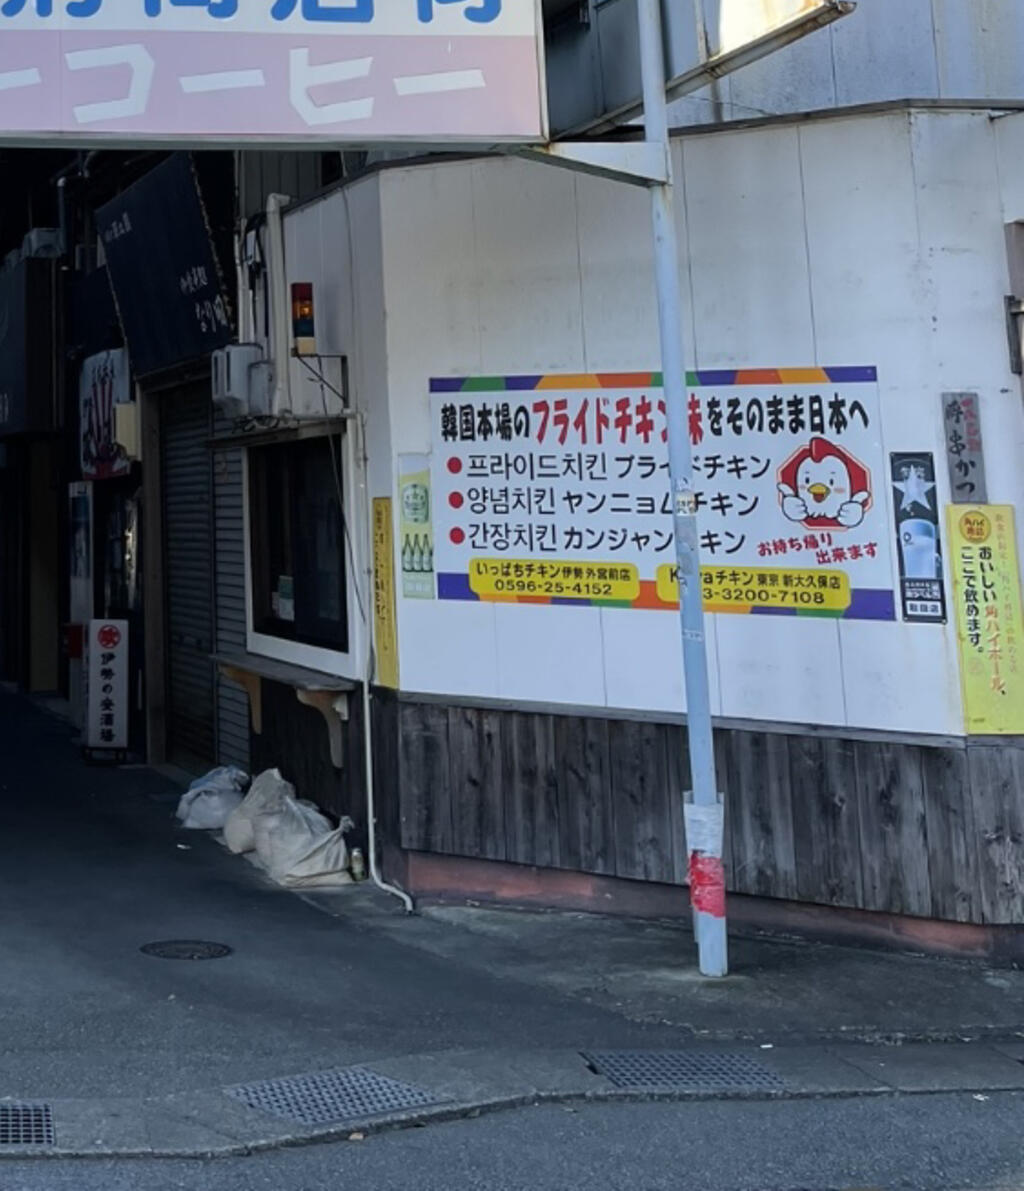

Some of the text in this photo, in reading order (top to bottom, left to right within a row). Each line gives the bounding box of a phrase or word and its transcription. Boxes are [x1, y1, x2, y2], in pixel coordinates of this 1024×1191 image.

[467, 452, 608, 481] 프라이드치킨
[467, 486, 556, 515] 양념치킨
[468, 522, 557, 552] 간장치킨
[564, 526, 746, 555] カンジャンキン
[757, 532, 832, 556] お持ち帰り
[816, 542, 877, 565] 出来ます
[495, 579, 613, 595] 0596-25-4152
[783, 575, 841, 590] 新大久保店
[702, 588, 825, 604] 3-3200-7108
